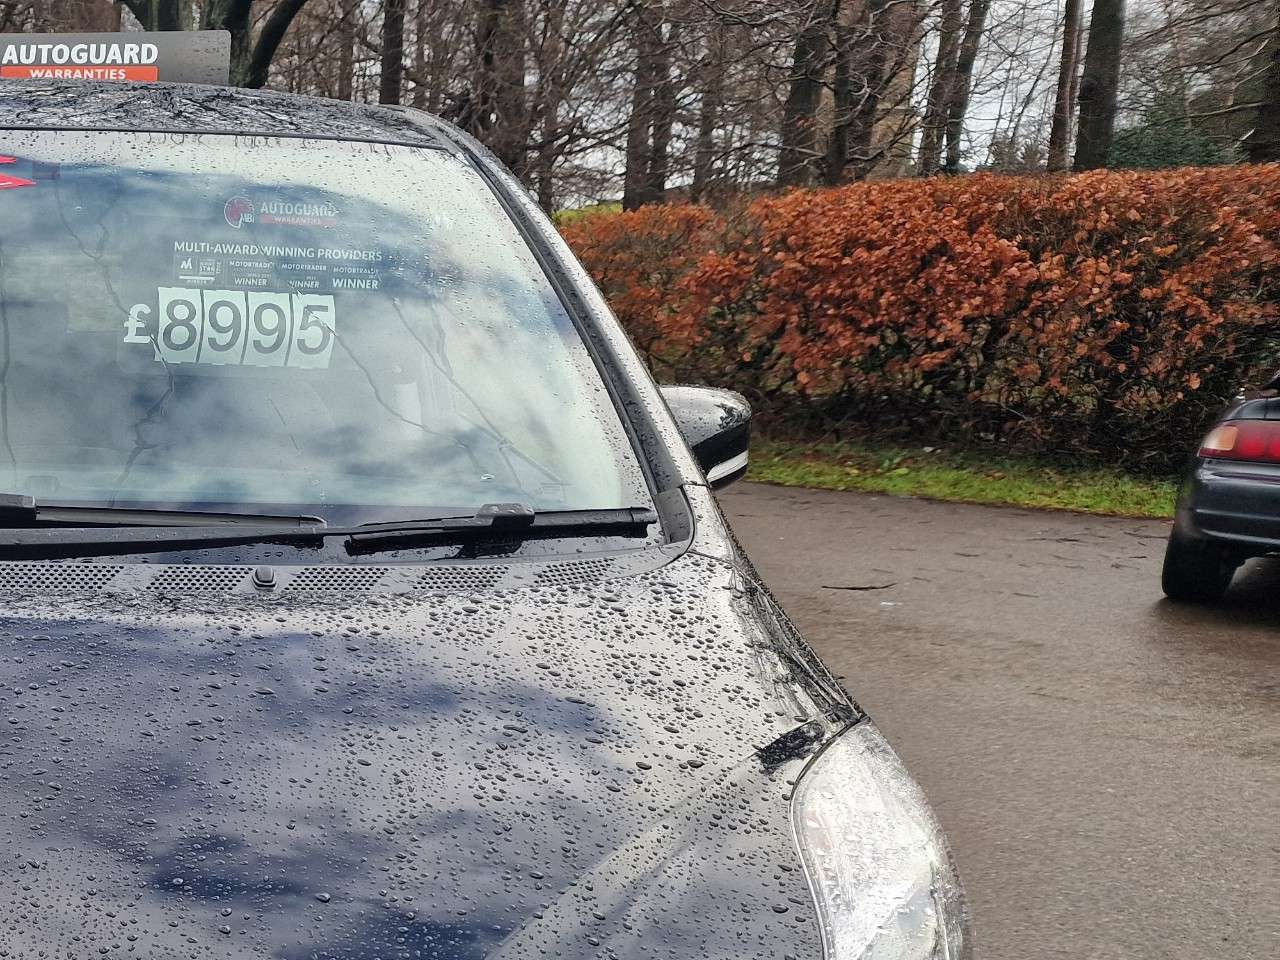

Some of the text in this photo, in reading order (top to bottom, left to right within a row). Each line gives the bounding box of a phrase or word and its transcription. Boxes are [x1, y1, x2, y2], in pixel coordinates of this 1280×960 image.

[1, 43, 159, 65] AUTOGUARD
[29, 68, 126, 80] WARRANTIES
[260, 202, 337, 217] AUTOGUARD
[174, 241, 382, 261] MULTI-AWARD WINNING PROVIDERS
[234, 277, 268, 287] WINNER
[332, 278, 378, 289] WINNER
